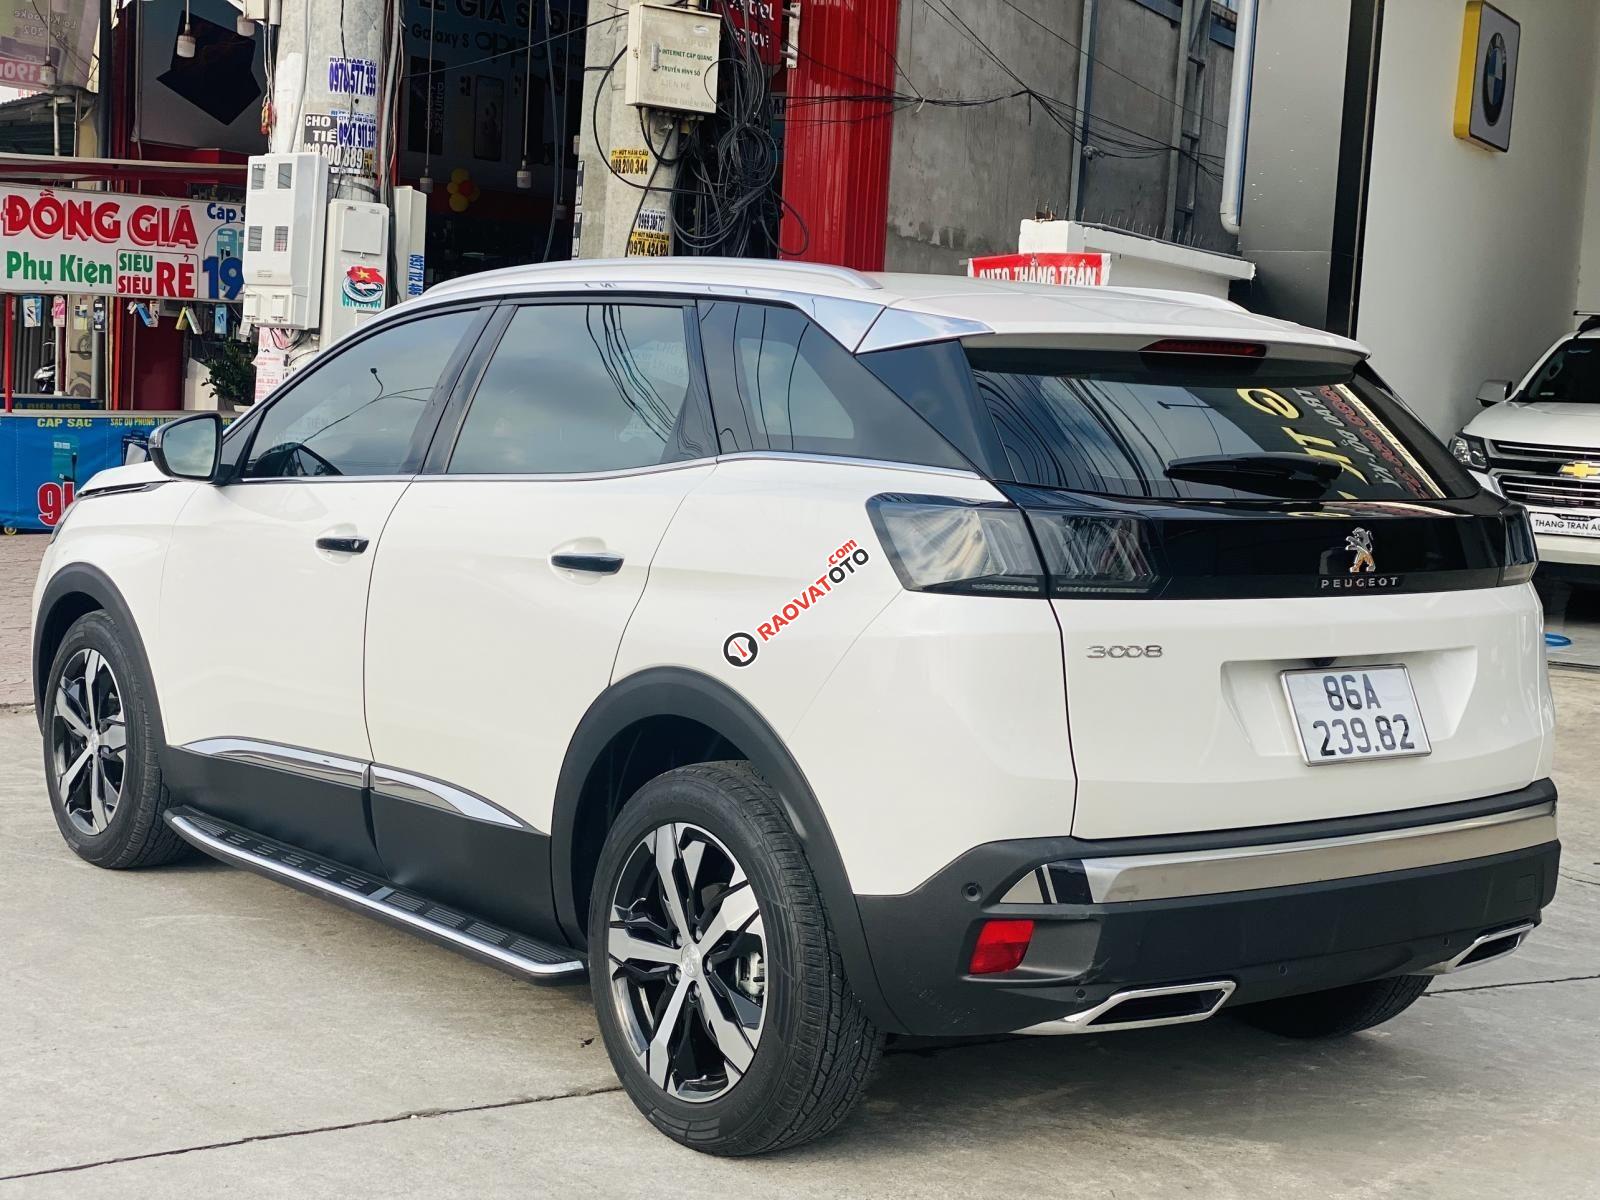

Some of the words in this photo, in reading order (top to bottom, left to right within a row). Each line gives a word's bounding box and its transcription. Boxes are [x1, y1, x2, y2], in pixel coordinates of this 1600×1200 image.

[662, 48, 686, 58] INTERNET
[697, 54, 713, 62] QUANG
[305, 115, 331, 127] CHO
[1, 188, 121, 244] ĐỒNG
[128, 204, 199, 249] GIÁ
[6, 250, 53, 285] Phụ
[60, 253, 113, 287] Kiện
[119, 252, 153, 273] SIÊU
[118, 274, 152, 295] SIÊU
[156, 254, 196, 298] RẺ
[979, 267, 1010, 281] AUTO
[1535, 519, 1564, 529] THANG
[1567, 521, 1589, 531] TRAN
[1320, 576, 1400, 589] PEUGEOT
[1086, 644, 1163, 659] 3008
[1323, 674, 1382, 712] 86A
[1312, 712, 1415, 757] 239.82
